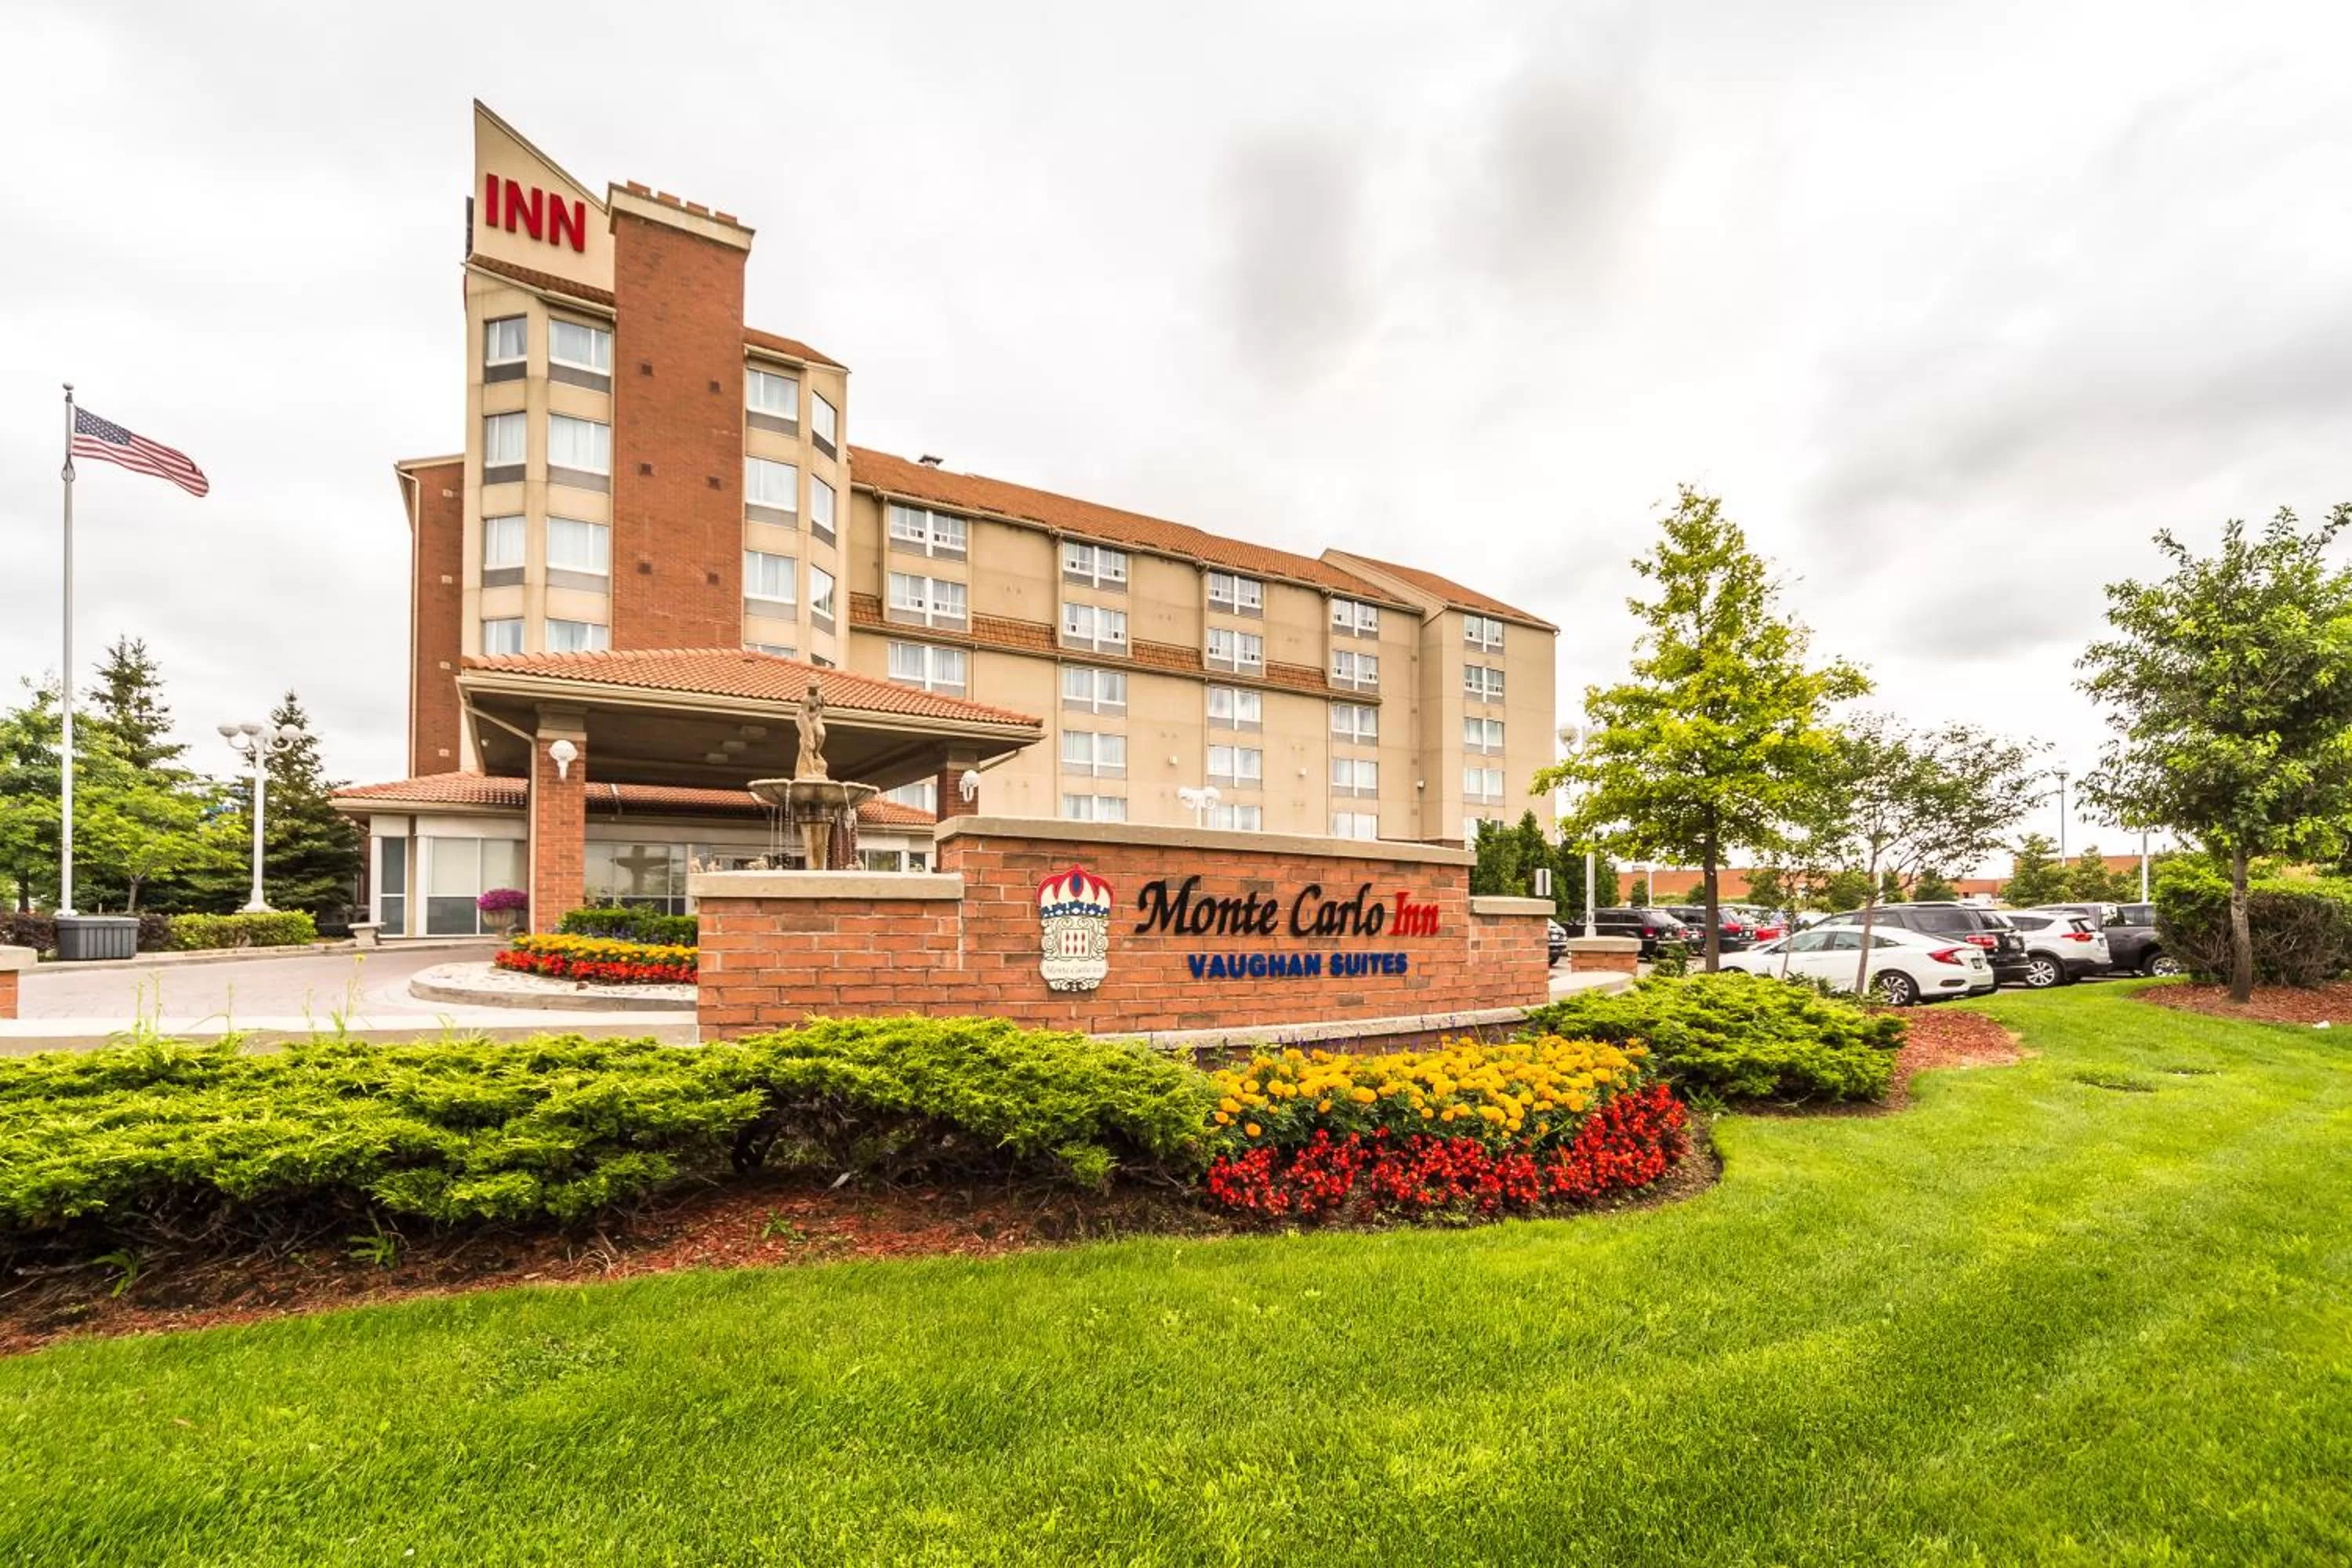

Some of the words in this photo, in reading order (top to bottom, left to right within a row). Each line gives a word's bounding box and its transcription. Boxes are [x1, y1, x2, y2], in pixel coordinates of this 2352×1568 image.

[486, 173, 585, 252] INN
[1135, 874, 1279, 935] Monte
[1290, 882, 1385, 936] Carlo
[1387, 891, 1439, 937] Inn
[1188, 953, 1322, 978] VAUGHAN
[1329, 953, 1408, 976] SUITES
